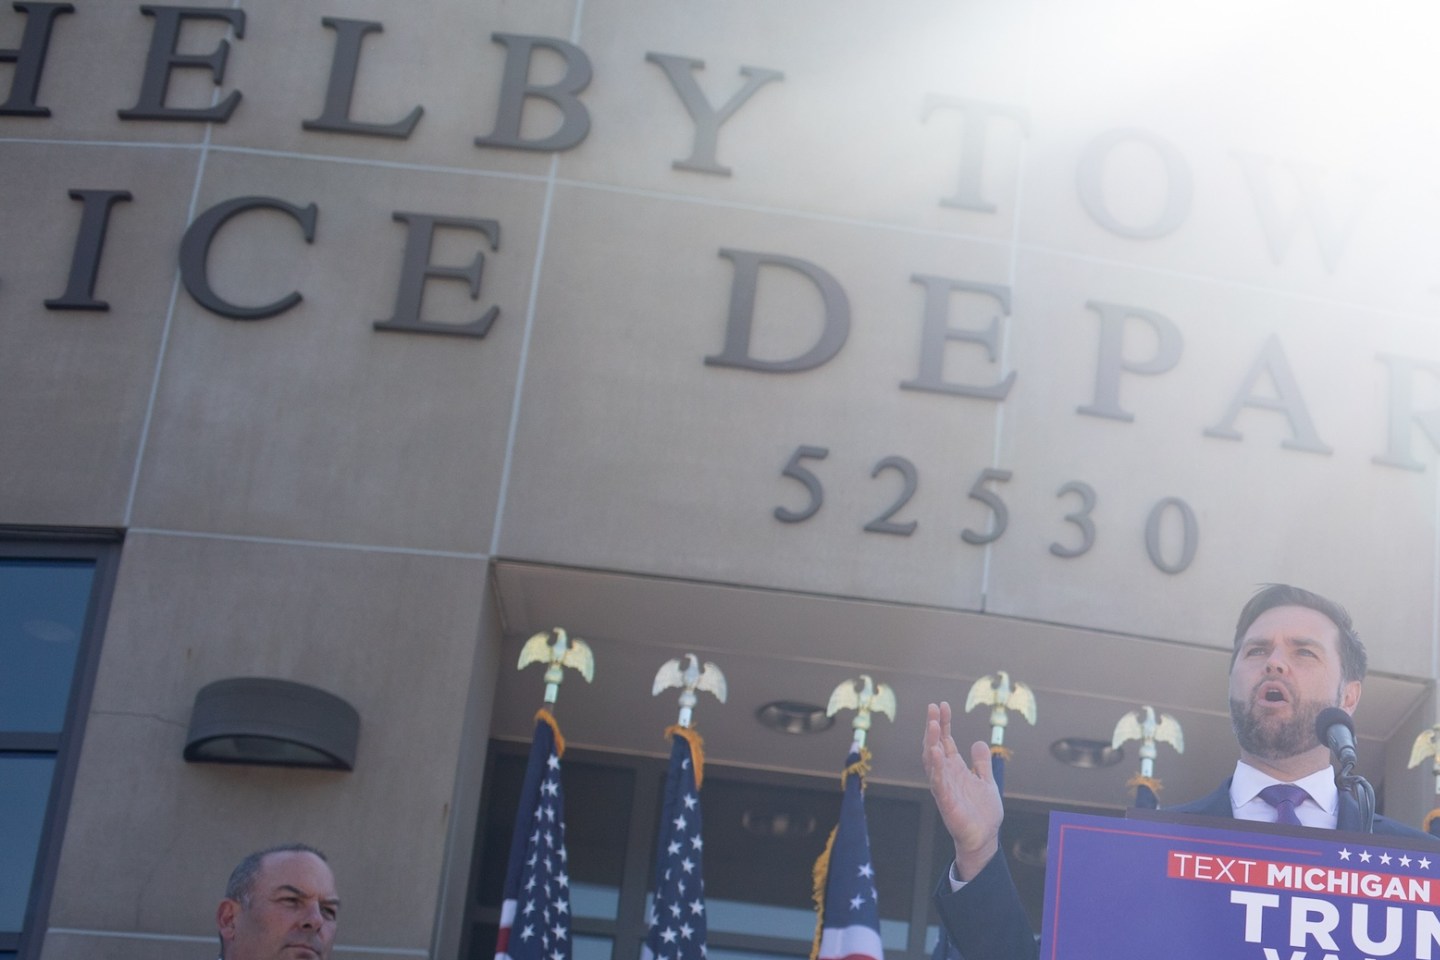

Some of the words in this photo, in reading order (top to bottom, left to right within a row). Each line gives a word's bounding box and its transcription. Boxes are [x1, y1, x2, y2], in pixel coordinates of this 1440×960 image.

[773, 445, 1199, 576] 52530
[1173, 853, 1257, 883] TEXT
[1267, 863, 1431, 903] MICHIGAN
